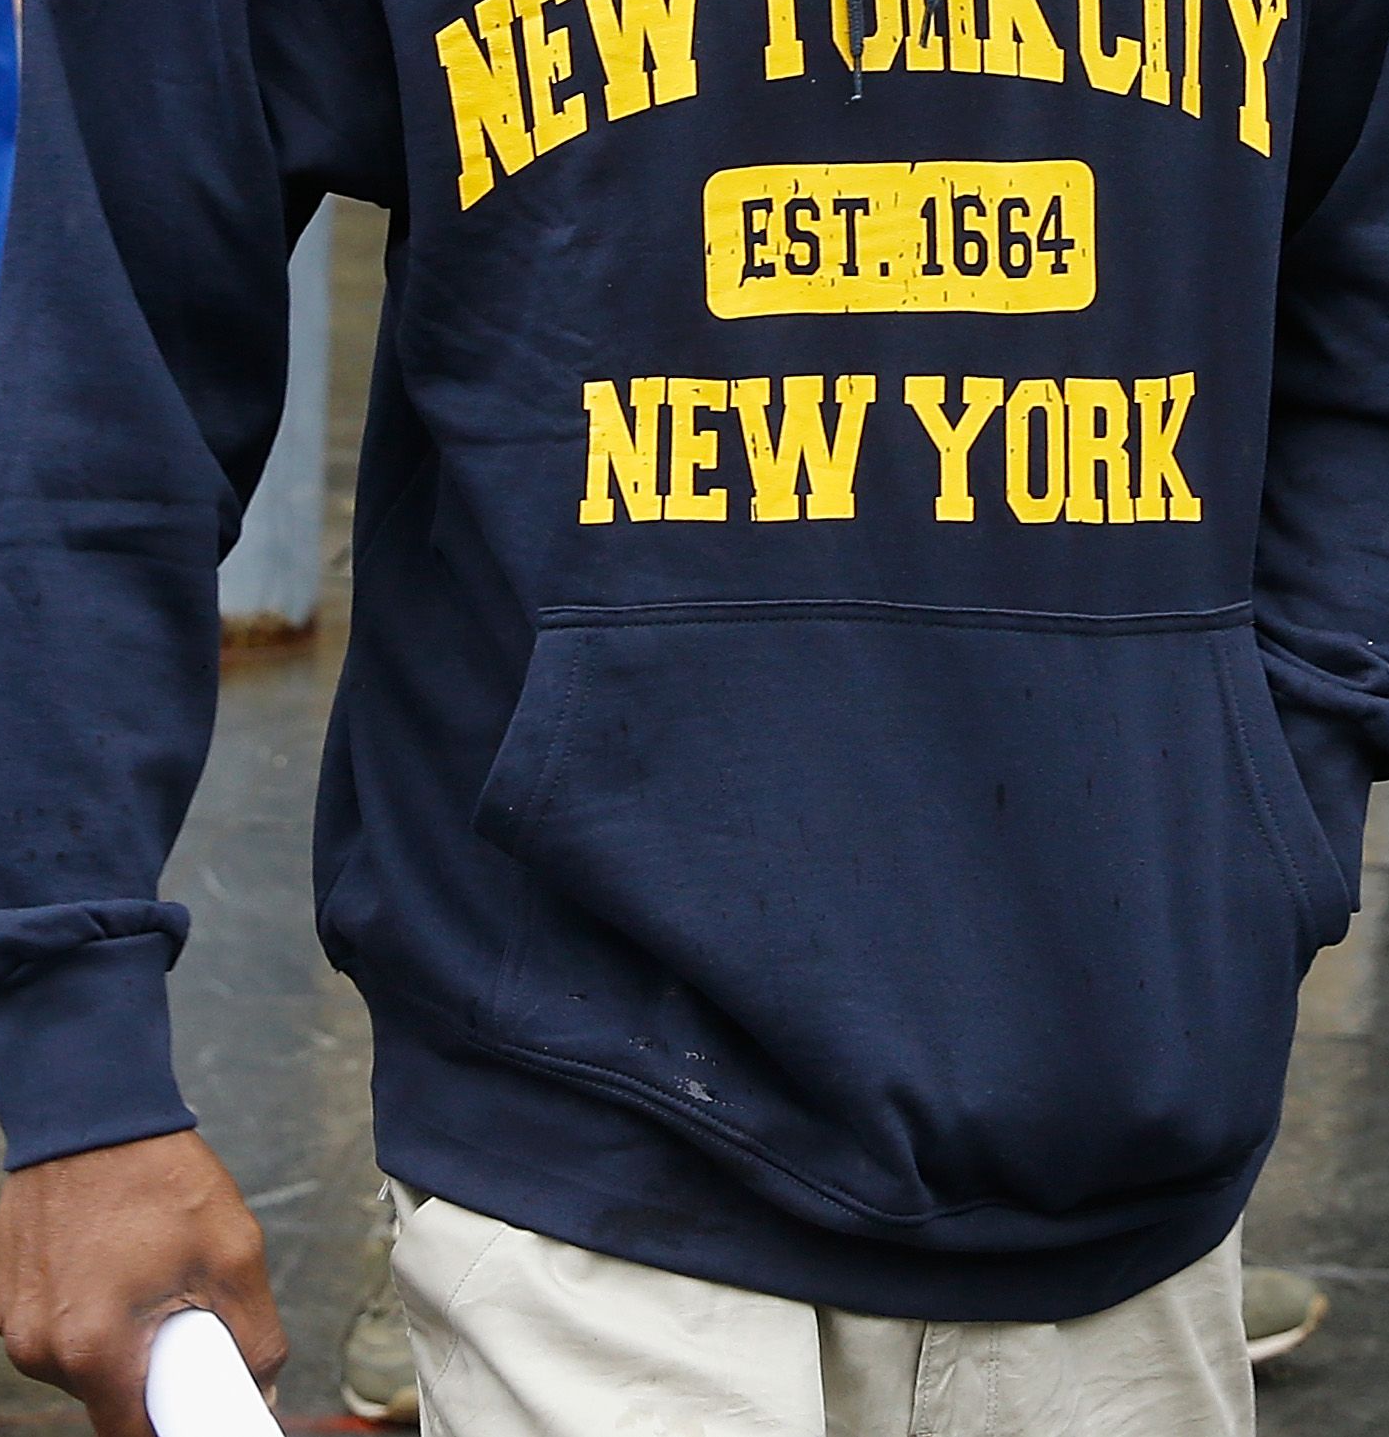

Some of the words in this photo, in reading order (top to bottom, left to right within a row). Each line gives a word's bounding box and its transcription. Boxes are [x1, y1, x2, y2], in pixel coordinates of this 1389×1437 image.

[739, 197, 889, 286] EST.
[920, 190, 1075, 278] 1664
[579, 375, 877, 524] NEW
[903, 372, 1202, 525] YORK
